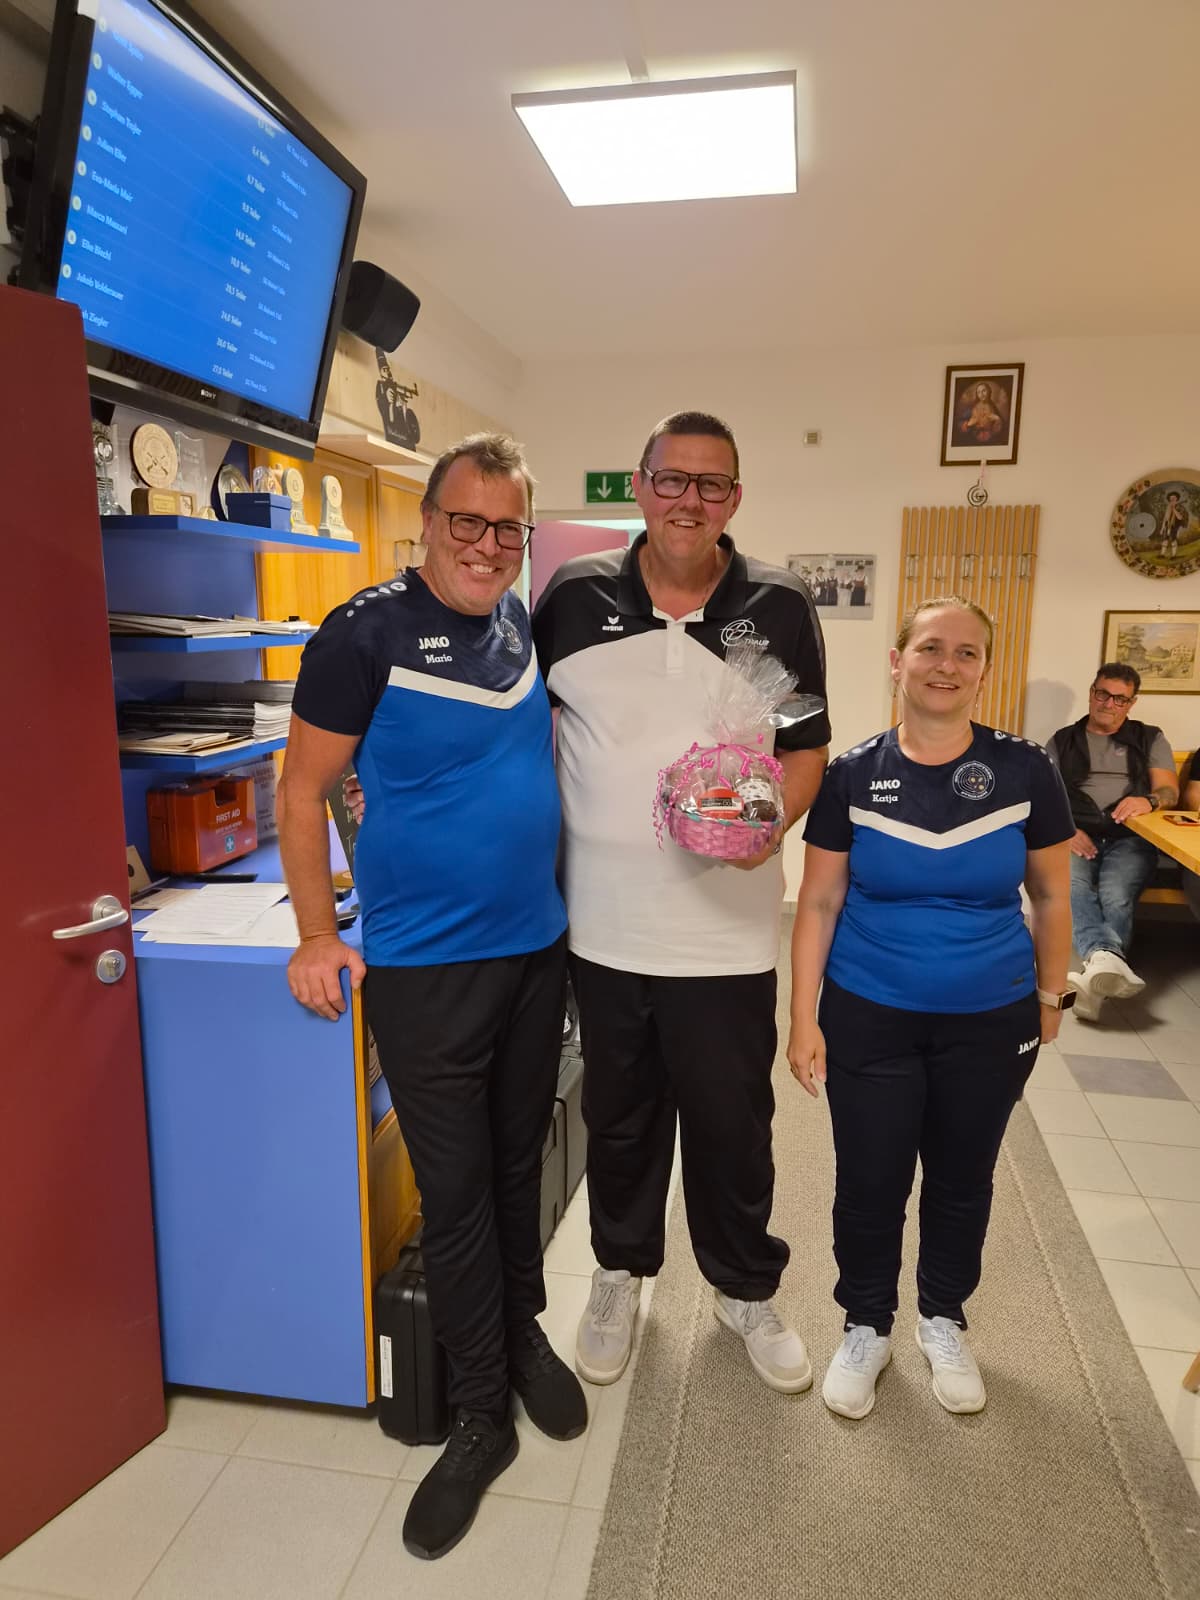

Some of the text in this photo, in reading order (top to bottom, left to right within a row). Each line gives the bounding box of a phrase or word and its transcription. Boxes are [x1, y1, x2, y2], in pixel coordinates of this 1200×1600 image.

[418, 636, 450, 650] JAKO
[424, 653, 453, 665] Mario
[869, 779, 901, 791] JAKO
[872, 794, 899, 804] Katja
[215, 808, 241, 824] FIRST AID
